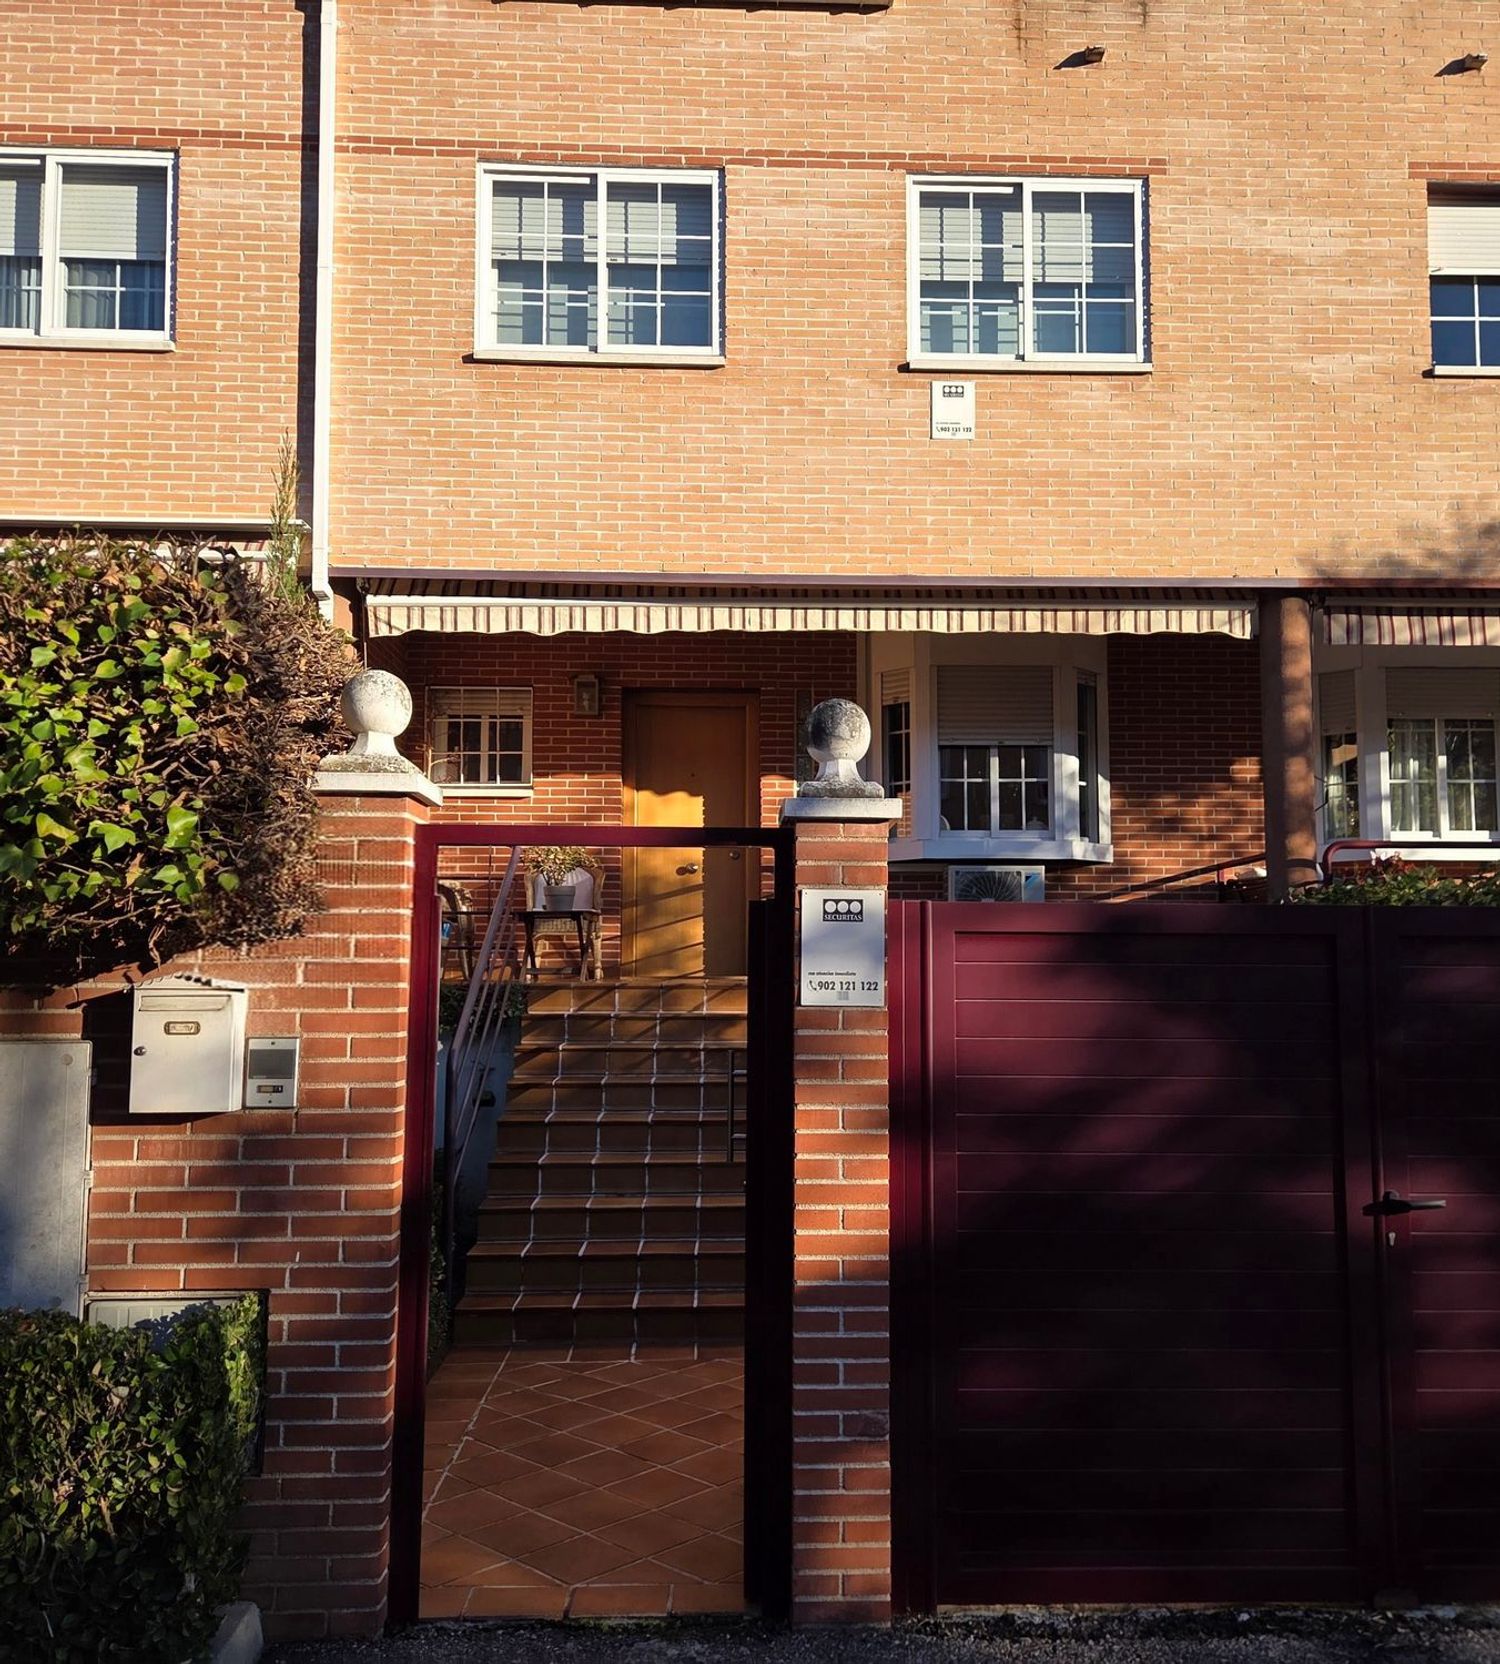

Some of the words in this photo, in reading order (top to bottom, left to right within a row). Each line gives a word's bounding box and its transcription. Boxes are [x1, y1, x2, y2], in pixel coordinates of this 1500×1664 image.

[817, 980, 836, 991] 902
[839, 981, 856, 991] 121
[861, 981, 879, 991] 122
